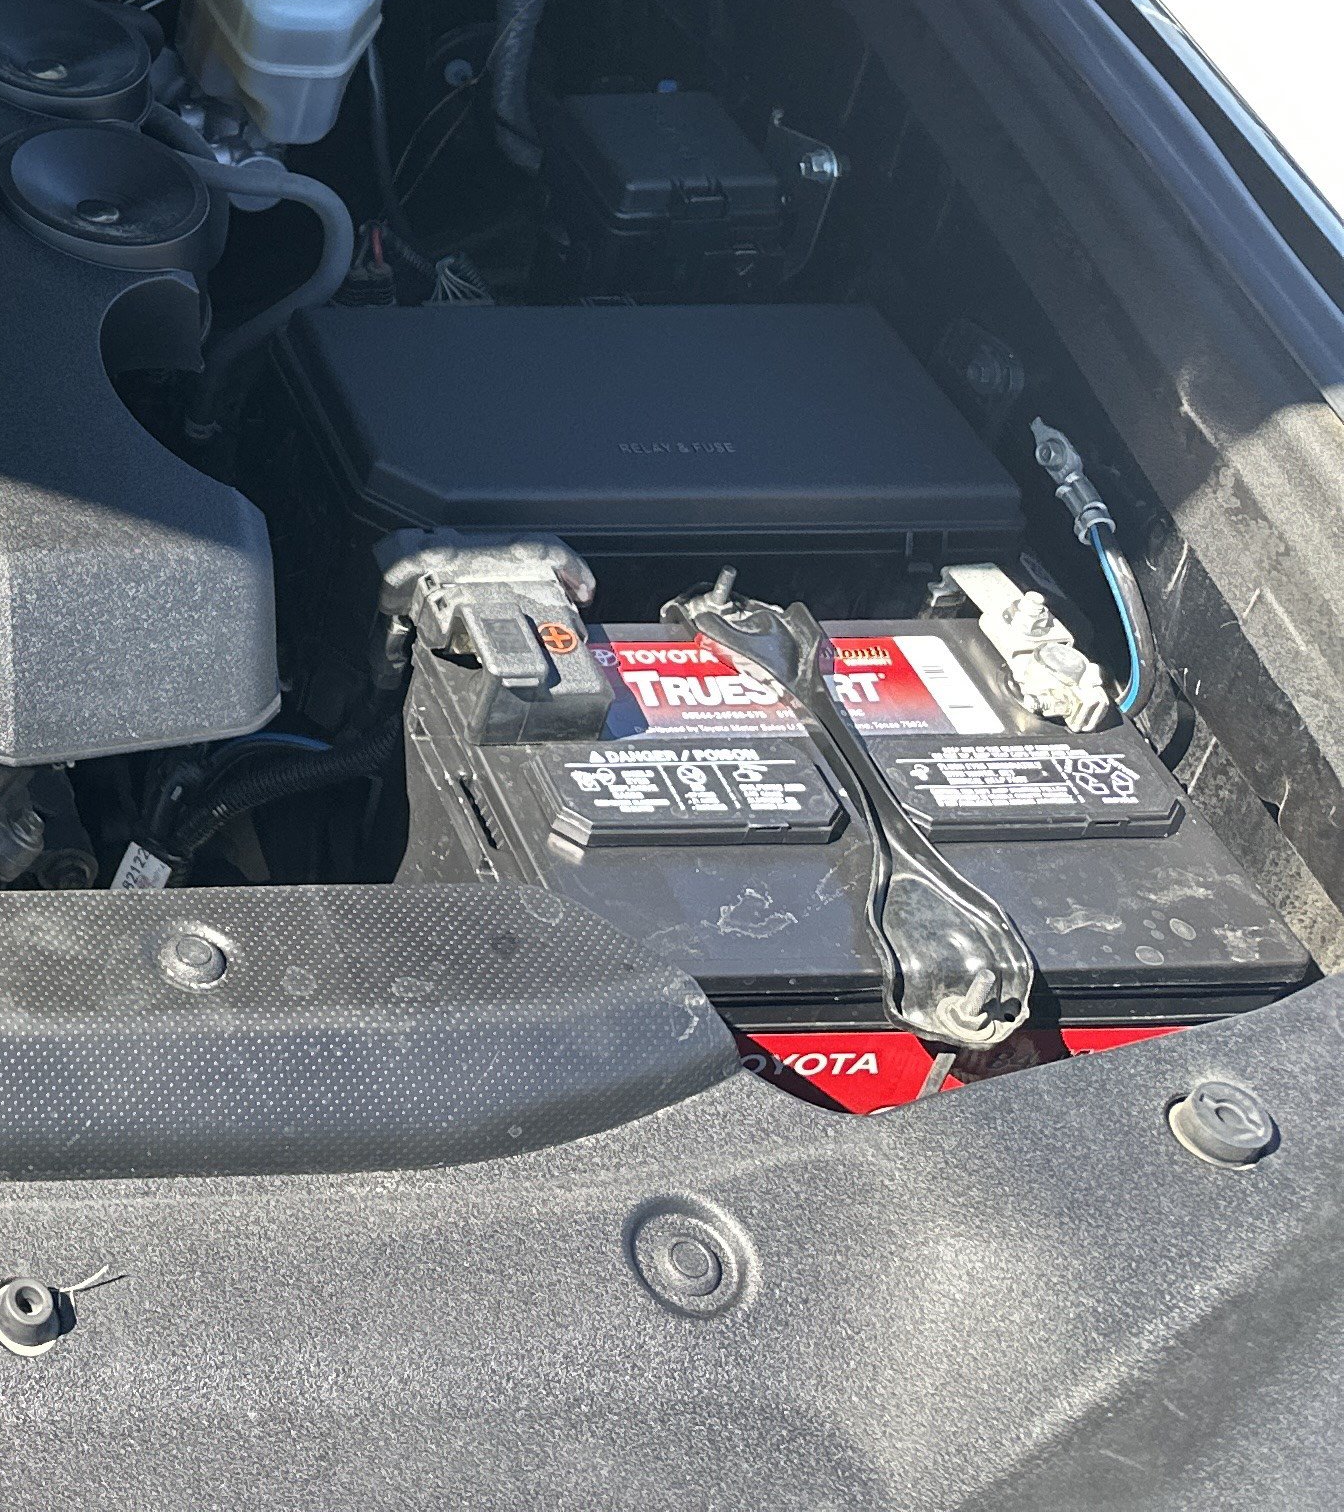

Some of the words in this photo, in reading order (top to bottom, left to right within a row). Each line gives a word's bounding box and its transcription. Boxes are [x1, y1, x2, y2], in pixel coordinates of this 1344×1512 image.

[618, 441, 671, 454] RELAY
[677, 441, 690, 453] &
[692, 441, 736, 454] FUSE
[620, 648, 719, 665] TOYOTA
[623, 670, 880, 708] TRUESRT
[605, 750, 679, 763] DANGER
[681, 750, 690, 762] /
[691, 749, 760, 762] POISON
[740, 1052, 879, 1076] OYOTA
